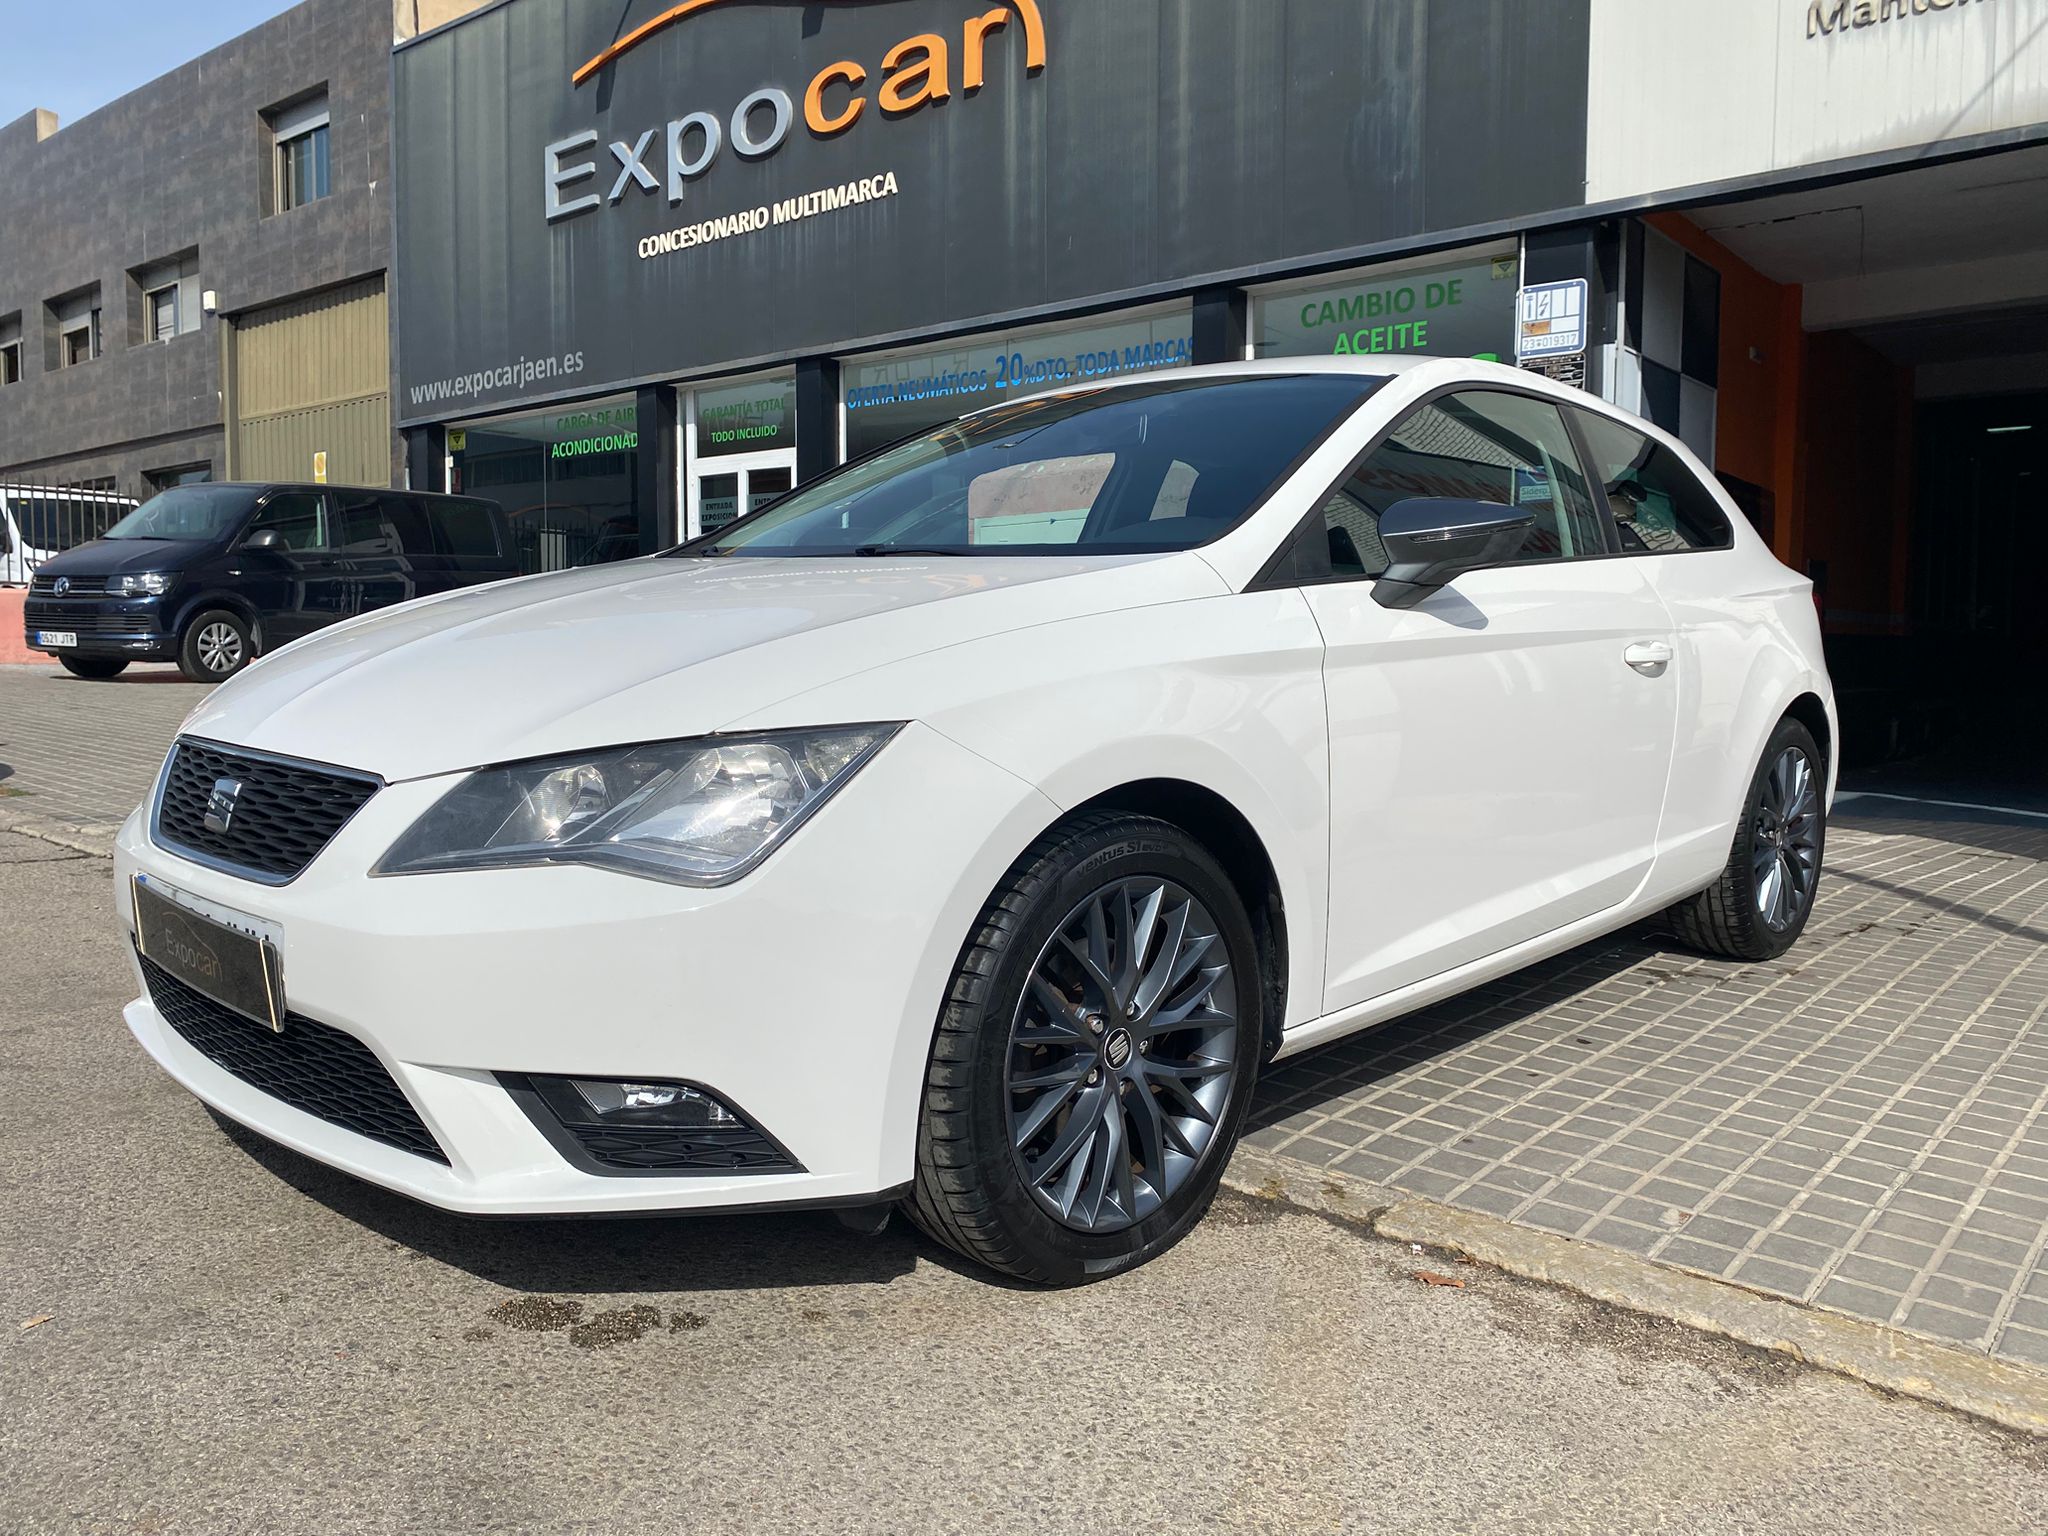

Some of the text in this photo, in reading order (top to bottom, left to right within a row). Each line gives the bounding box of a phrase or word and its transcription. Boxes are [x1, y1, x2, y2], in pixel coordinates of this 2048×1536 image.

[544, 6, 1012, 220] Expocar
[638, 171, 899, 259] CONCESIONARIO MULTIMARCA
[1300, 279, 1464, 328] CAMBIO DE
[1333, 320, 1429, 355] ACEITE
[410, 350, 585, 405] www.expocarjaen.es
[847, 384, 895, 409] OFERTA
[898, 369, 988, 401] NEUMÁTICOS
[1075, 349, 1120, 376] TODA
[556, 413, 593, 434] CARGA
[615, 404, 637, 422] AIR
[702, 399, 753, 421] GARANTÍA
[711, 424, 778, 443] TODO INCLUIDO
[706, 501, 733, 511] ENTRADA
[165, 927, 220, 978] Expocar
